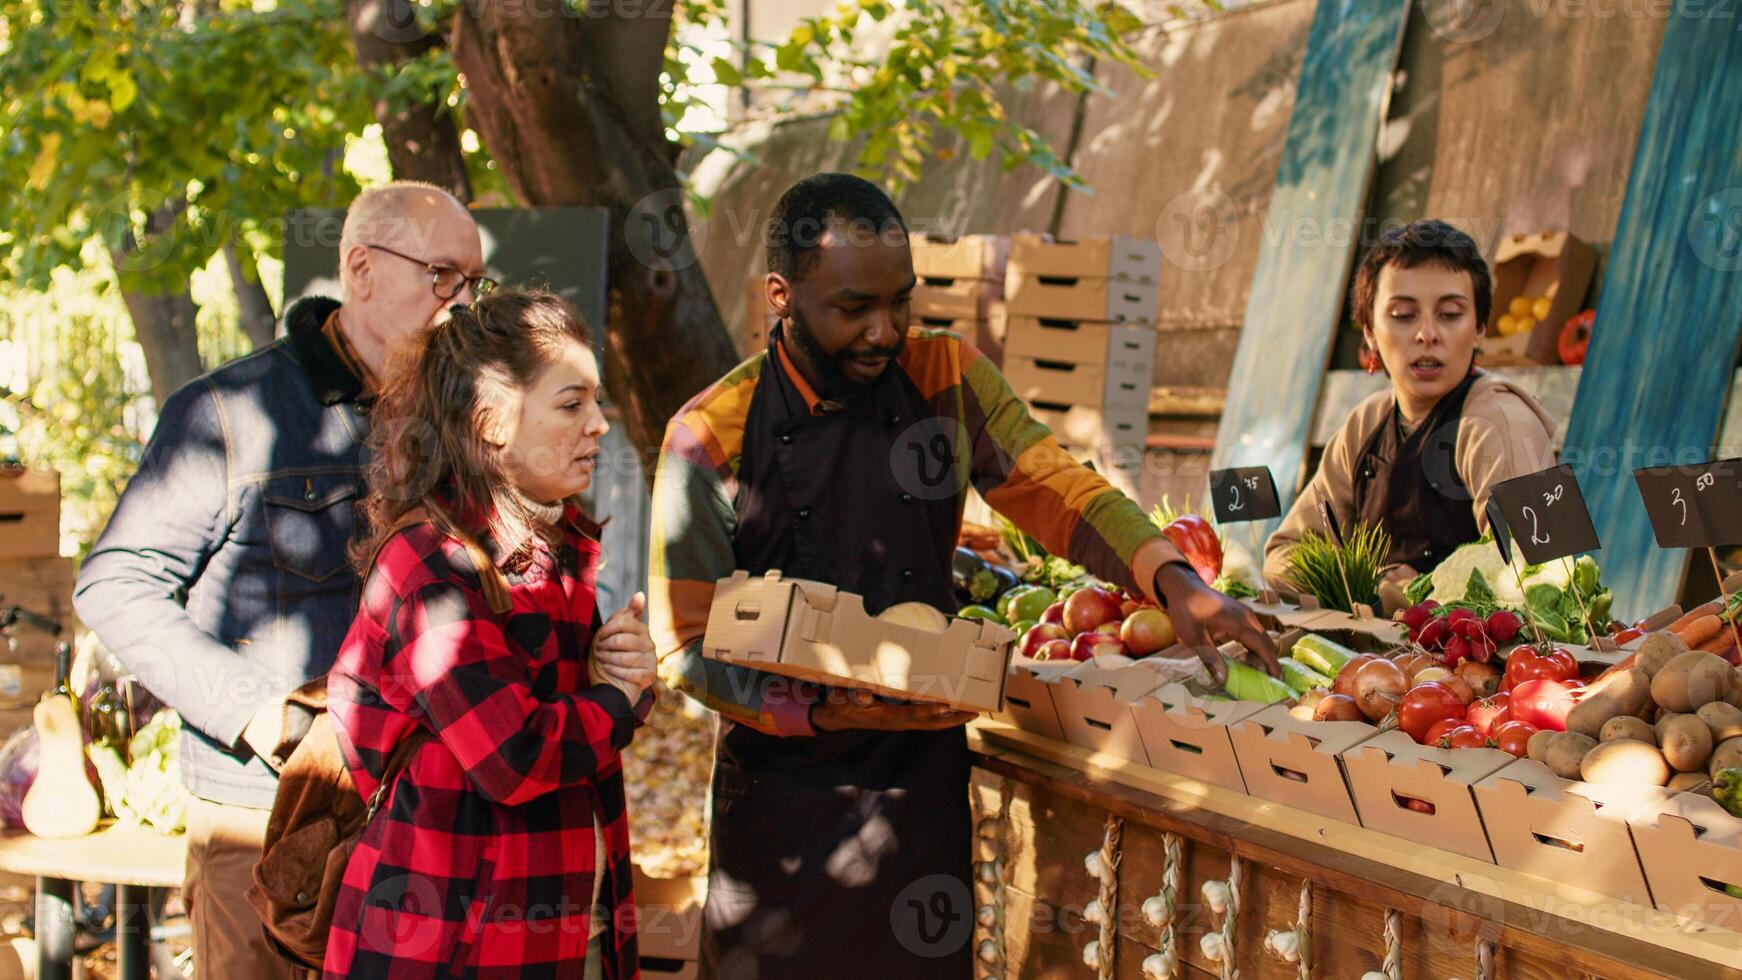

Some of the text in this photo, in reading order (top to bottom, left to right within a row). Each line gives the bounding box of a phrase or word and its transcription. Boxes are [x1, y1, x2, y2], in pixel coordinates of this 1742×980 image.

[1228, 476, 1260, 512] 2 75
[1522, 484, 1564, 546] 2 30
[1671, 472, 1714, 526] 3 50
